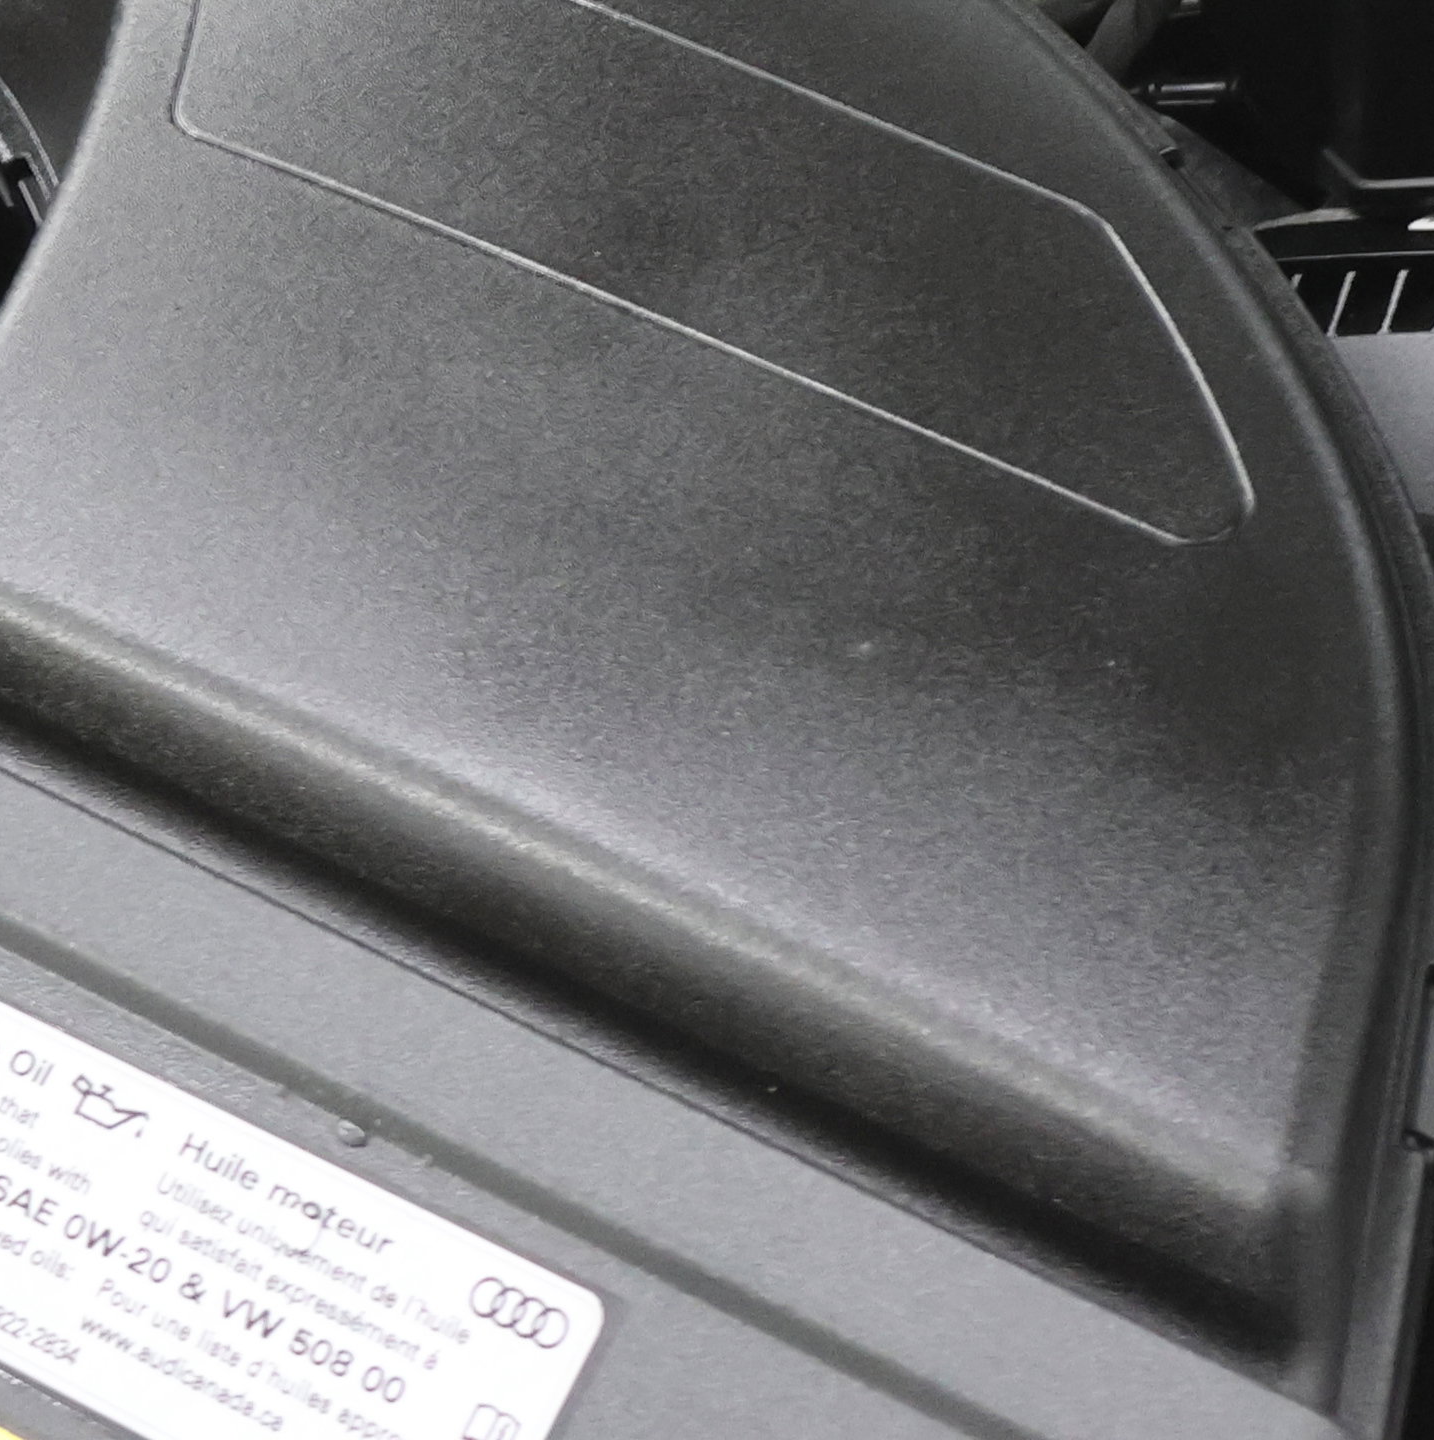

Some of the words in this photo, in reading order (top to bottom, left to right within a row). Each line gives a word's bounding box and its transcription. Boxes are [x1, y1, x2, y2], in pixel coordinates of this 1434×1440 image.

[8, 1049, 55, 1087] Oil
[47, 1164, 90, 1194] with
[178, 1133, 260, 1191] Huile
[267, 1183, 395, 1254] moteur
[30, 1250, 74, 1280] oils:
[140, 1210, 173, 1235] qui
[178, 1230, 263, 1282] satisfait
[265, 1274, 421, 1360] expressément
[157, 1174, 234, 1225] Utilisez
[236, 1219, 367, 1293] uniquement
[370, 1285, 398, 1309] de
[63, 1213, 172, 1284] 0W-20
[178, 1272, 207, 1305] &
[222, 1289, 286, 1340] VW
[288, 1327, 355, 1378] 508
[361, 1365, 406, 1404] 00
[97, 1278, 148, 1315] Pour
[152, 1312, 192, 1343] une
[198, 1331, 241, 1368] liste
[80, 1317, 284, 1432] www.audicanada.ca
